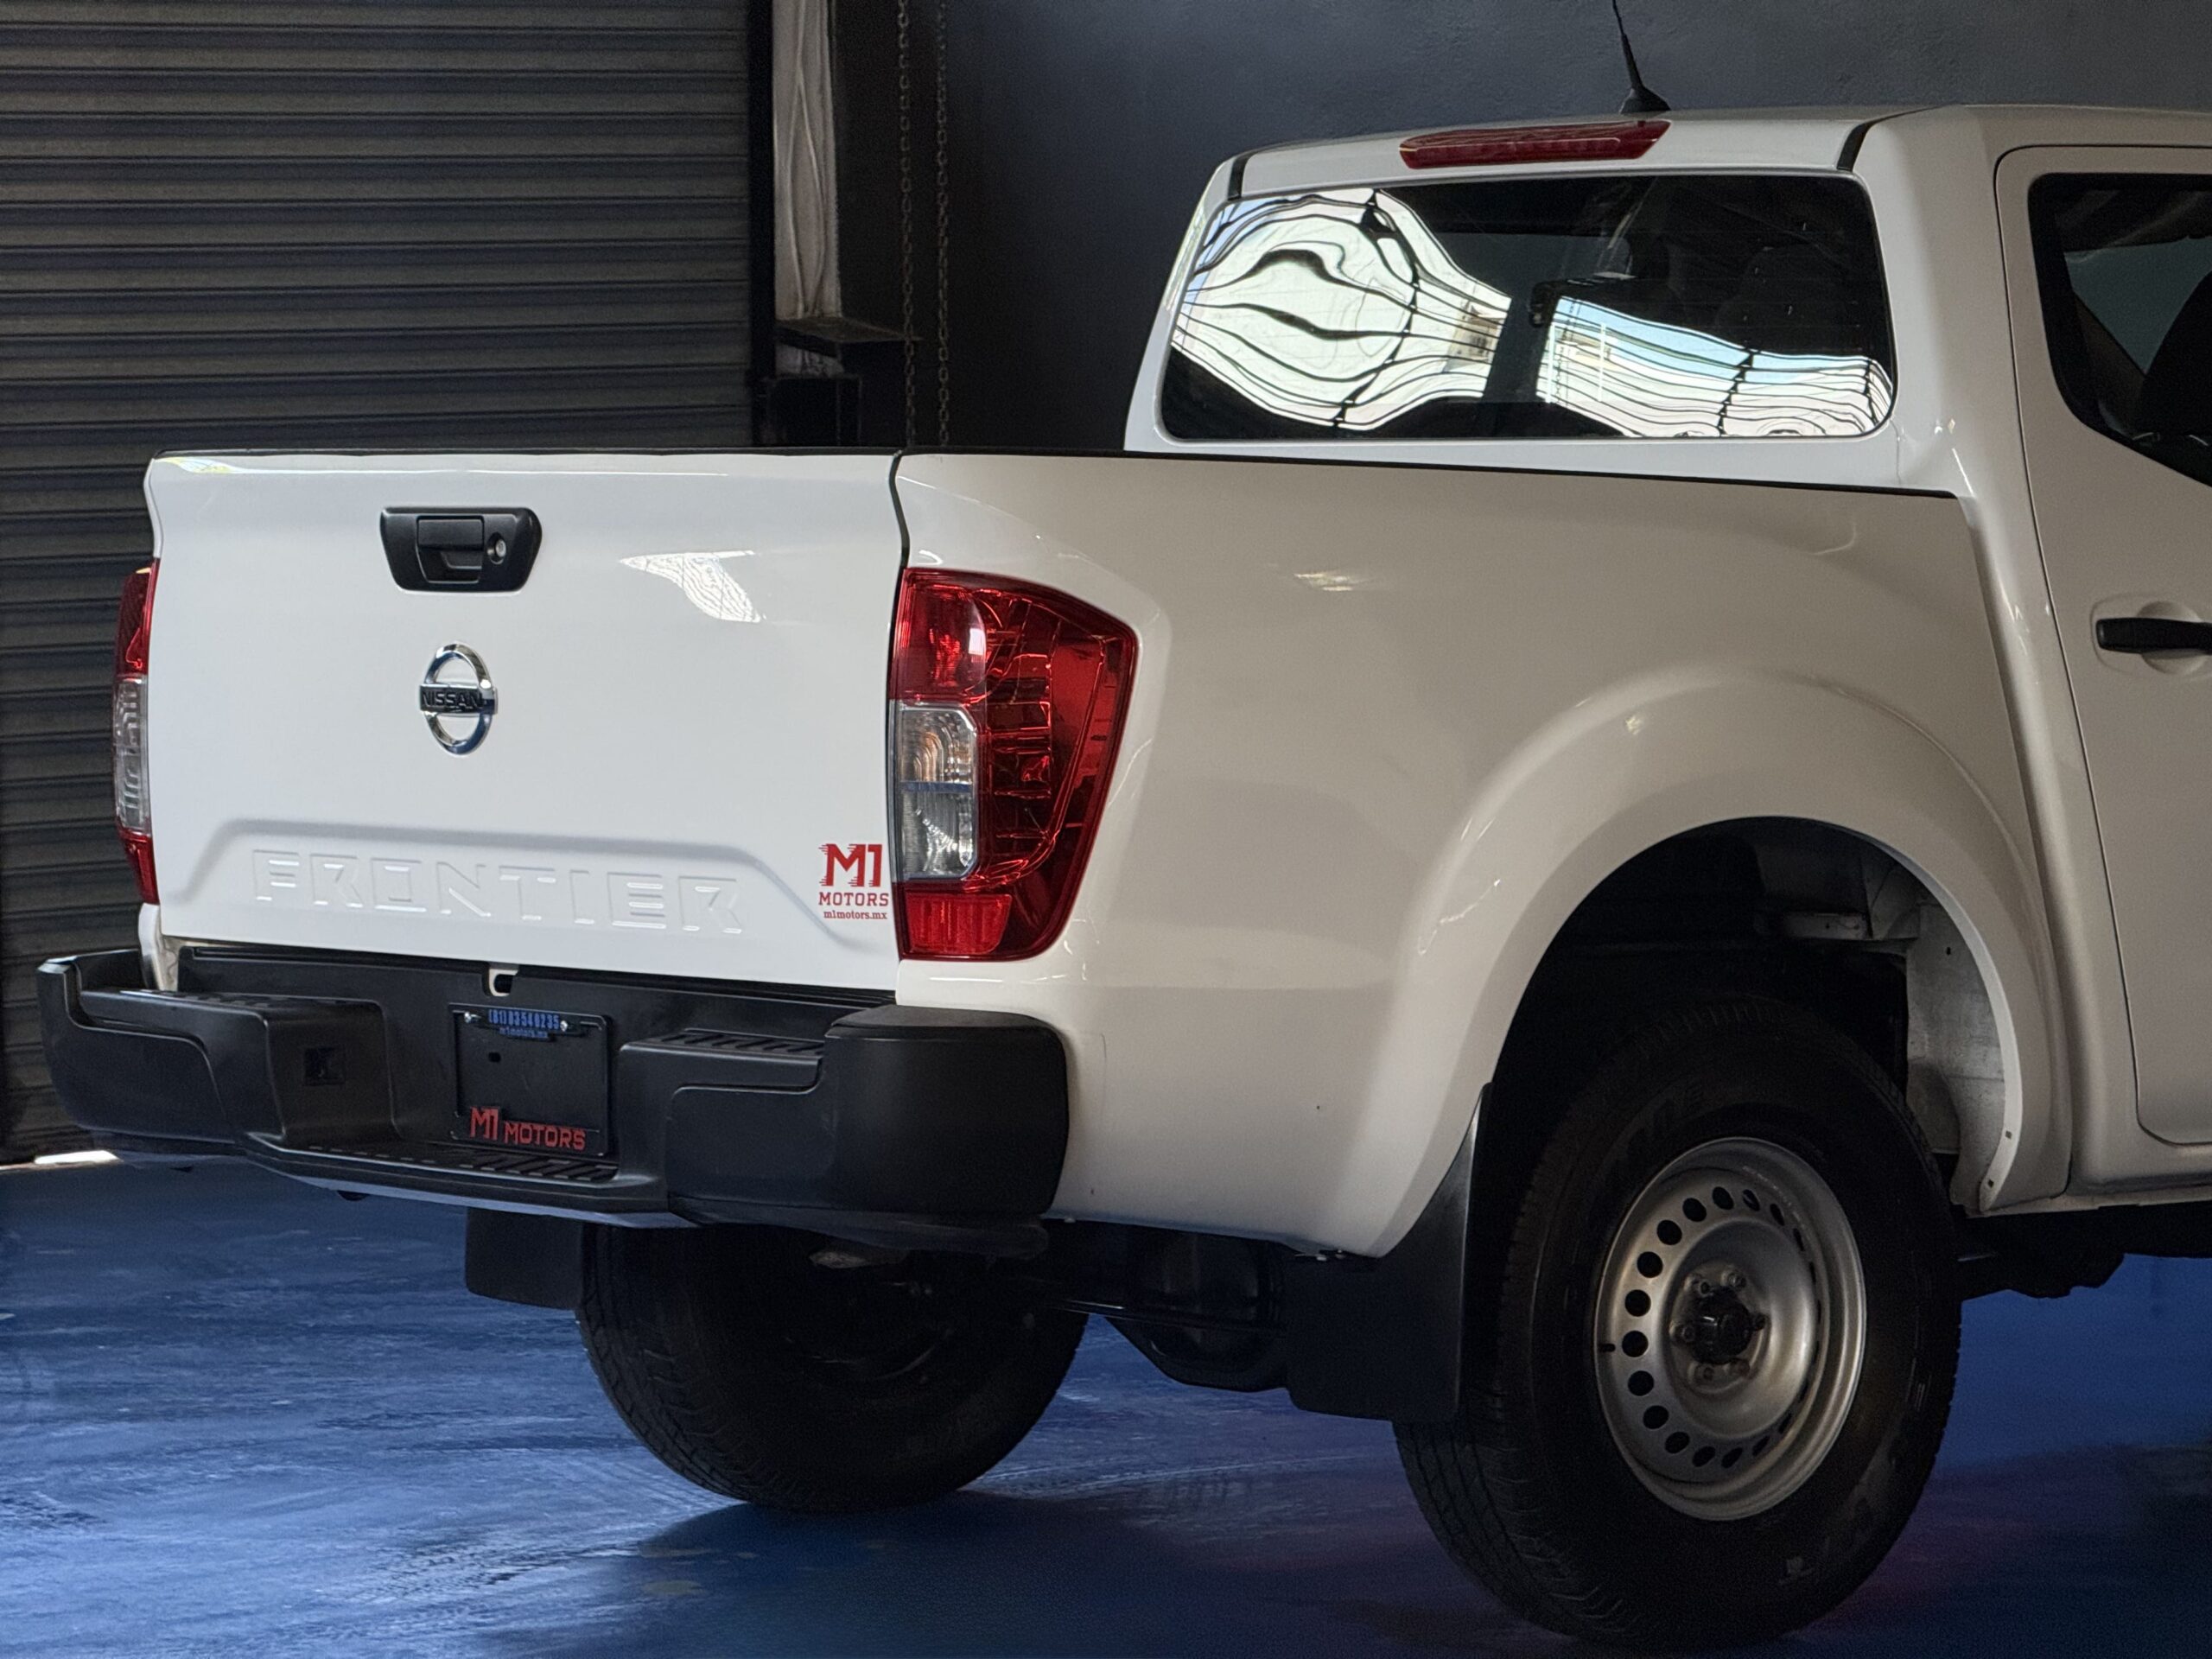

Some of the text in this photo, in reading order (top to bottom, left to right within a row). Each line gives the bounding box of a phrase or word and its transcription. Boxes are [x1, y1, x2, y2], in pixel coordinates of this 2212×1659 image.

[421, 689, 484, 709] NISSAN
[252, 849, 742, 935] FRONTIER
[818, 892, 889, 906] MOTORS
[505, 1121, 587, 1151] MOTORS
